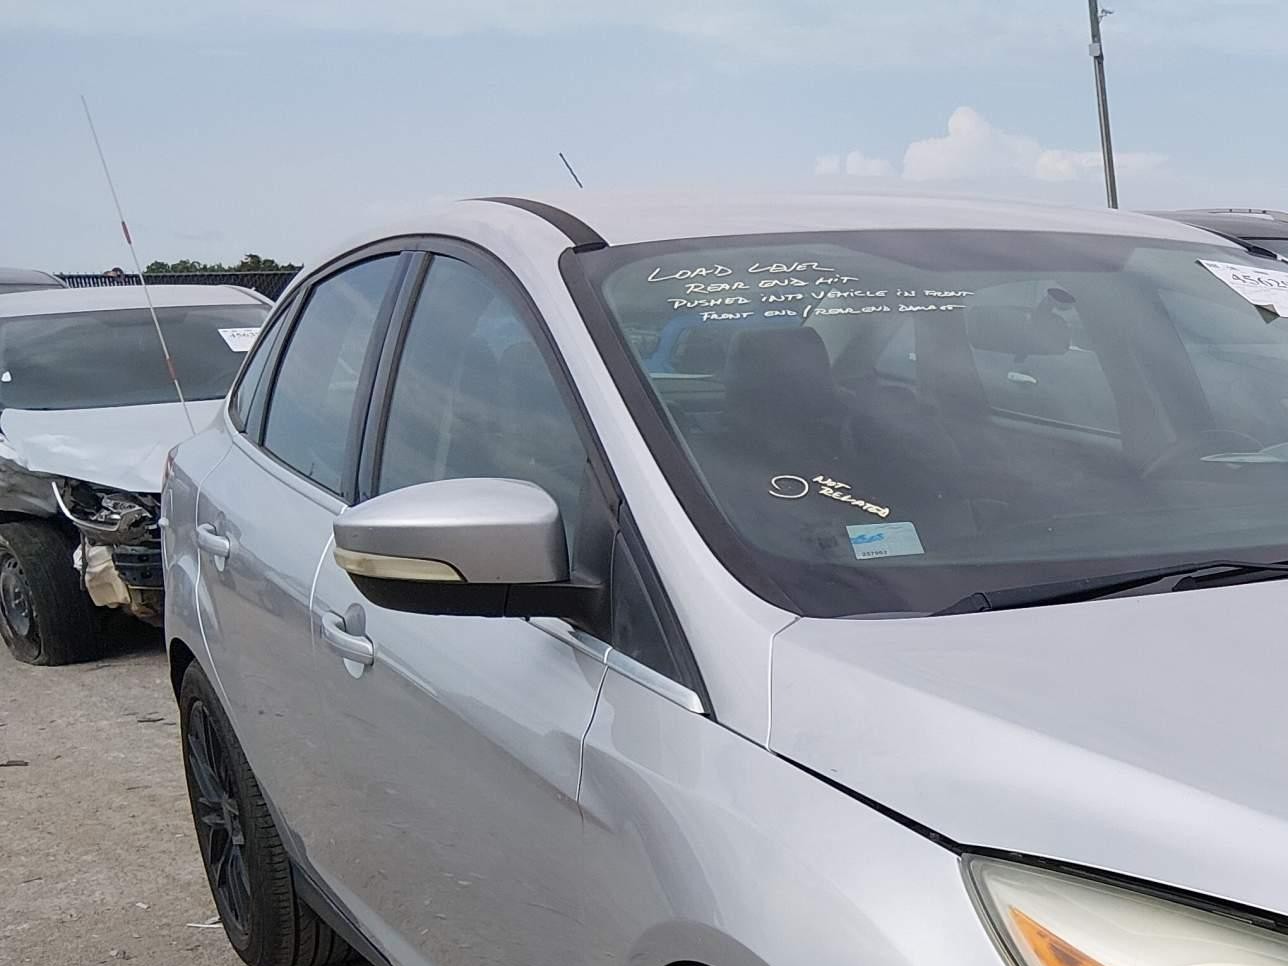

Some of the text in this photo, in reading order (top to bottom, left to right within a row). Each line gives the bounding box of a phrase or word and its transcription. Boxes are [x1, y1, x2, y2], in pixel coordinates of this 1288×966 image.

[647, 265, 732, 282] LOAD
[685, 282, 749, 294] REAR
[758, 277, 809, 288] END
[667, 297, 751, 309] PUSHED
[924, 289, 976, 297] FRONT
[700, 312, 754, 321] FRONT
[812, 475, 851, 489] NOT
